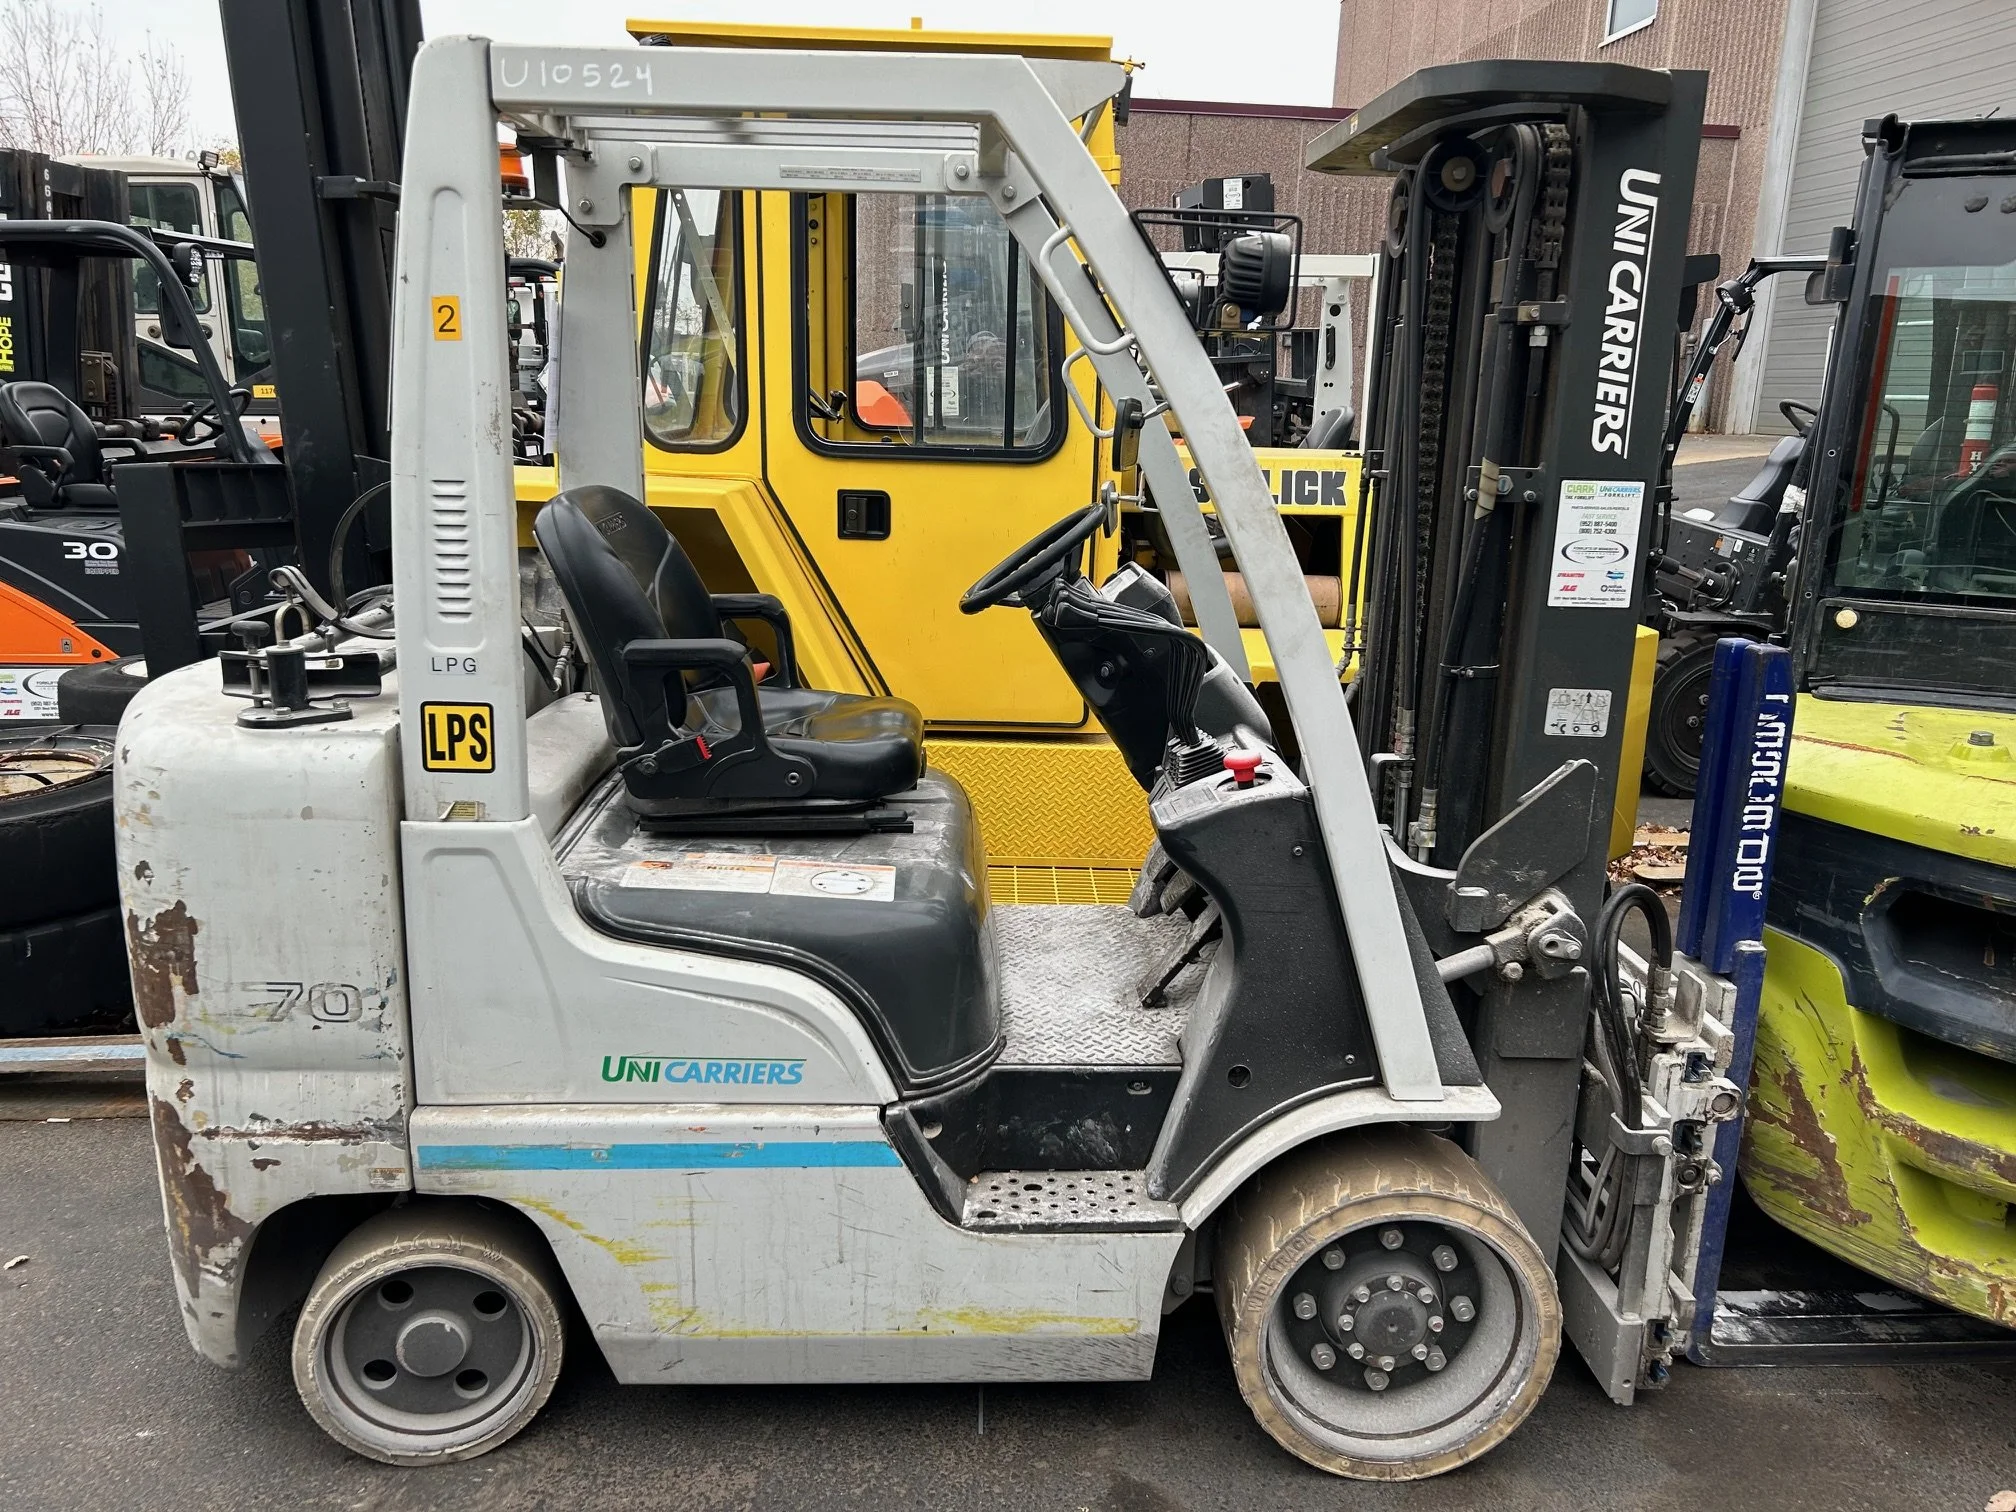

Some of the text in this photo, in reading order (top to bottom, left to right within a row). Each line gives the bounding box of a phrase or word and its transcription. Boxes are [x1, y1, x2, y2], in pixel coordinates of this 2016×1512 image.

[437, 304, 457, 333] 2
[1590, 167, 1662, 460] UNICARRIERS
[1188, 467, 1347, 506] SICK
[62, 541, 119, 560] 30
[1559, 584, 1578, 592] JLG
[431, 657, 478, 673] LPG
[428, 713, 489, 763] LPS
[240, 980, 364, 1023] 70
[601, 1055, 807, 1086] UNICARRIERS
